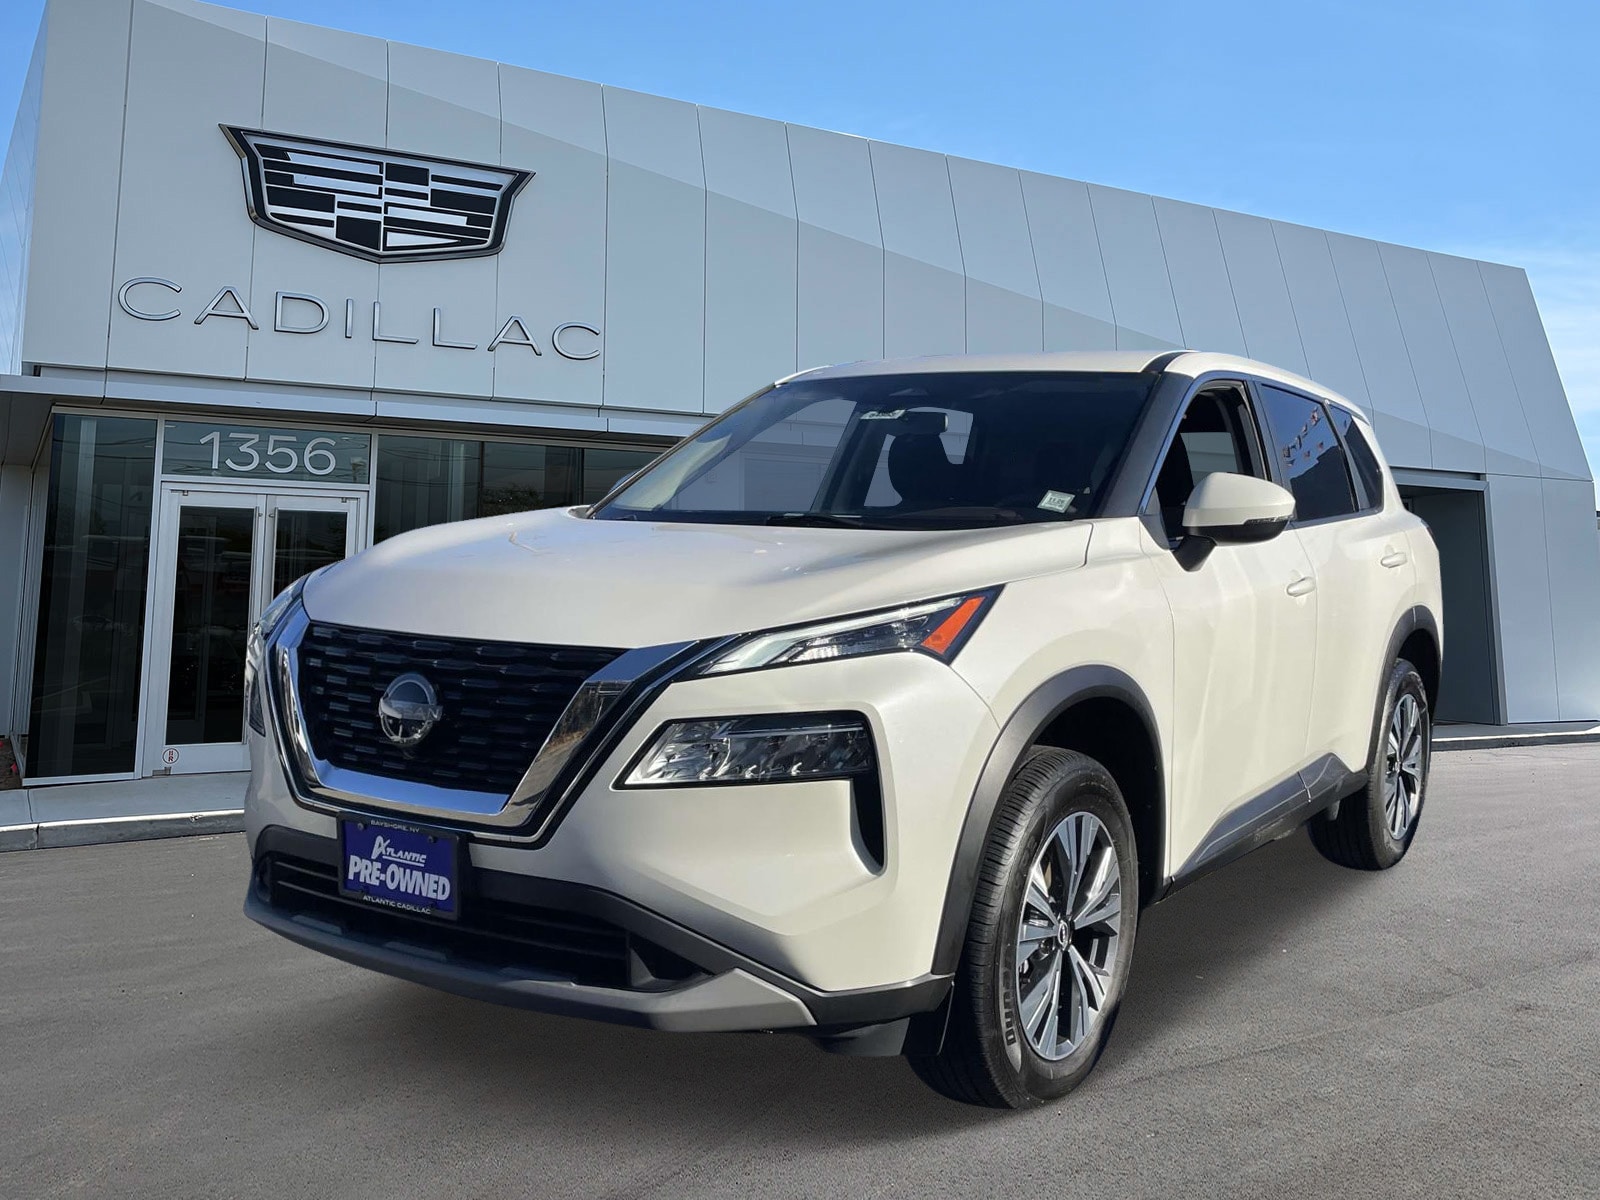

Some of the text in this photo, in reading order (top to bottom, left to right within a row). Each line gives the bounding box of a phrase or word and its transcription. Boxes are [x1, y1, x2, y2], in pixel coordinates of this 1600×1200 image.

[117, 276, 602, 361] CADILLAC
[199, 431, 337, 476] 1356
[348, 855, 451, 901] PRE-OWNED
[363, 895, 431, 915] ATLANTIC CADILLAC
